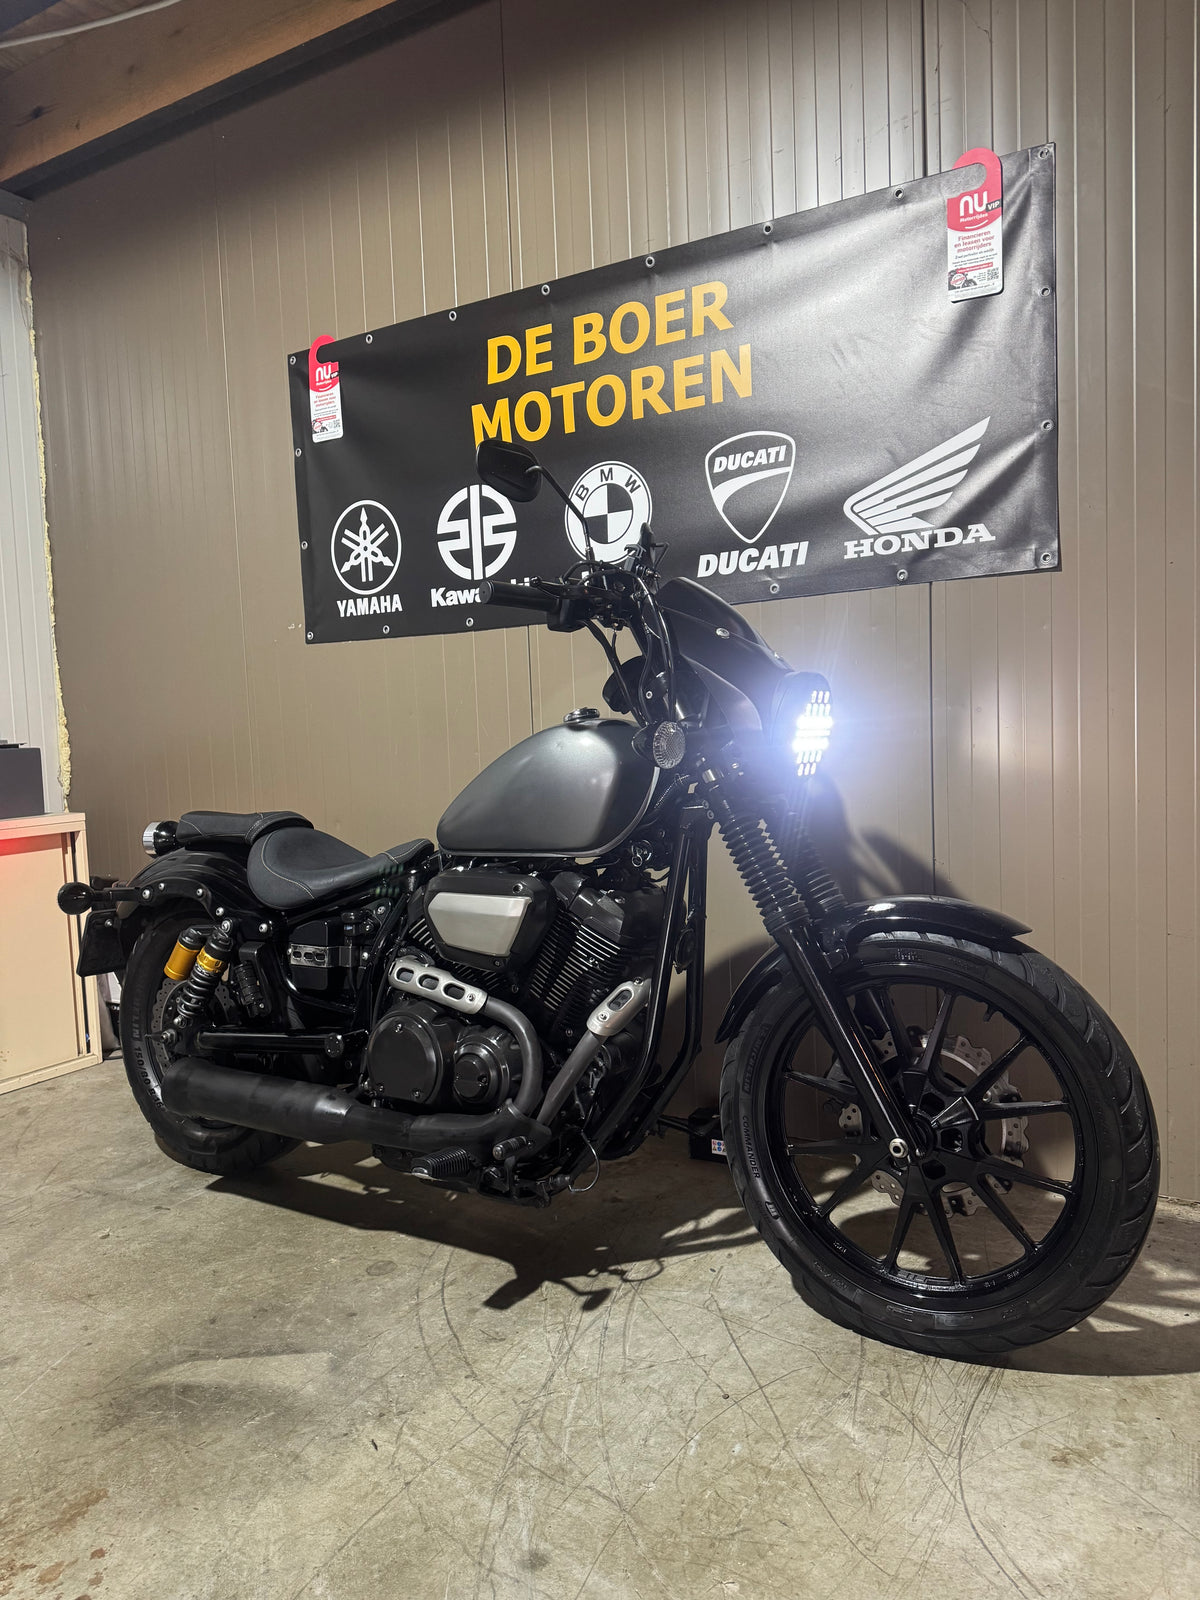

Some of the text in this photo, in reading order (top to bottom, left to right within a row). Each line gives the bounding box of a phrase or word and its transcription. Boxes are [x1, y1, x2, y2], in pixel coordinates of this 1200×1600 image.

[960, 191, 988, 217] nu
[987, 200, 1000, 210] VIP
[956, 241, 992, 254] motorrijders
[958, 231, 991, 241] Financieren
[962, 238, 981, 247] leasen
[981, 234, 996, 242] voor
[487, 280, 735, 385] DE BOER
[471, 343, 753, 451] MOTOREN
[713, 445, 787, 474] DUCATI
[843, 523, 996, 560] HONDA
[697, 541, 809, 578] DUCATI
[336, 593, 403, 618] YAMAHA
[742, 1115, 761, 1179] COMMANDER
